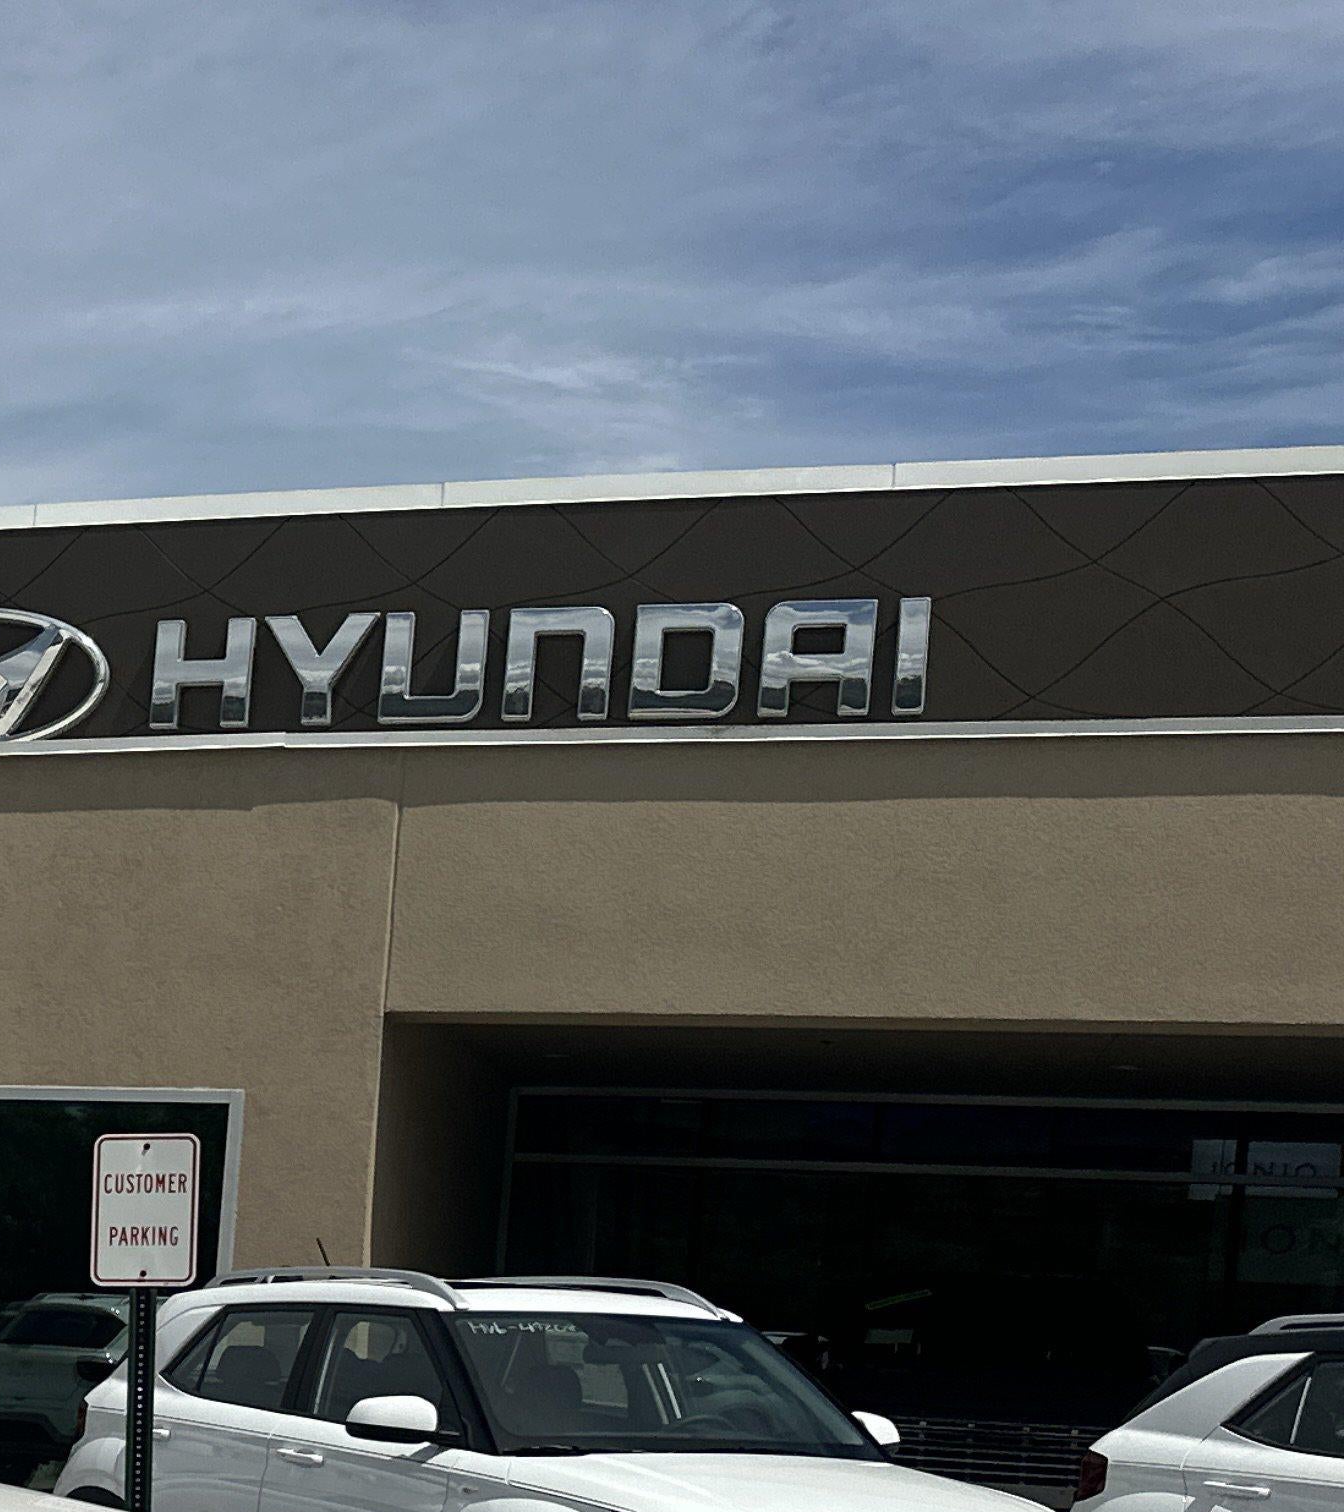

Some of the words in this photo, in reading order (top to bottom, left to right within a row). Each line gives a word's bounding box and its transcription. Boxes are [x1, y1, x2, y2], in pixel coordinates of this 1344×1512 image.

[149, 596, 933, 729] HYUNDAI
[103, 1173, 188, 1194] CUSTOMER
[109, 1226, 179, 1247] PARKING
